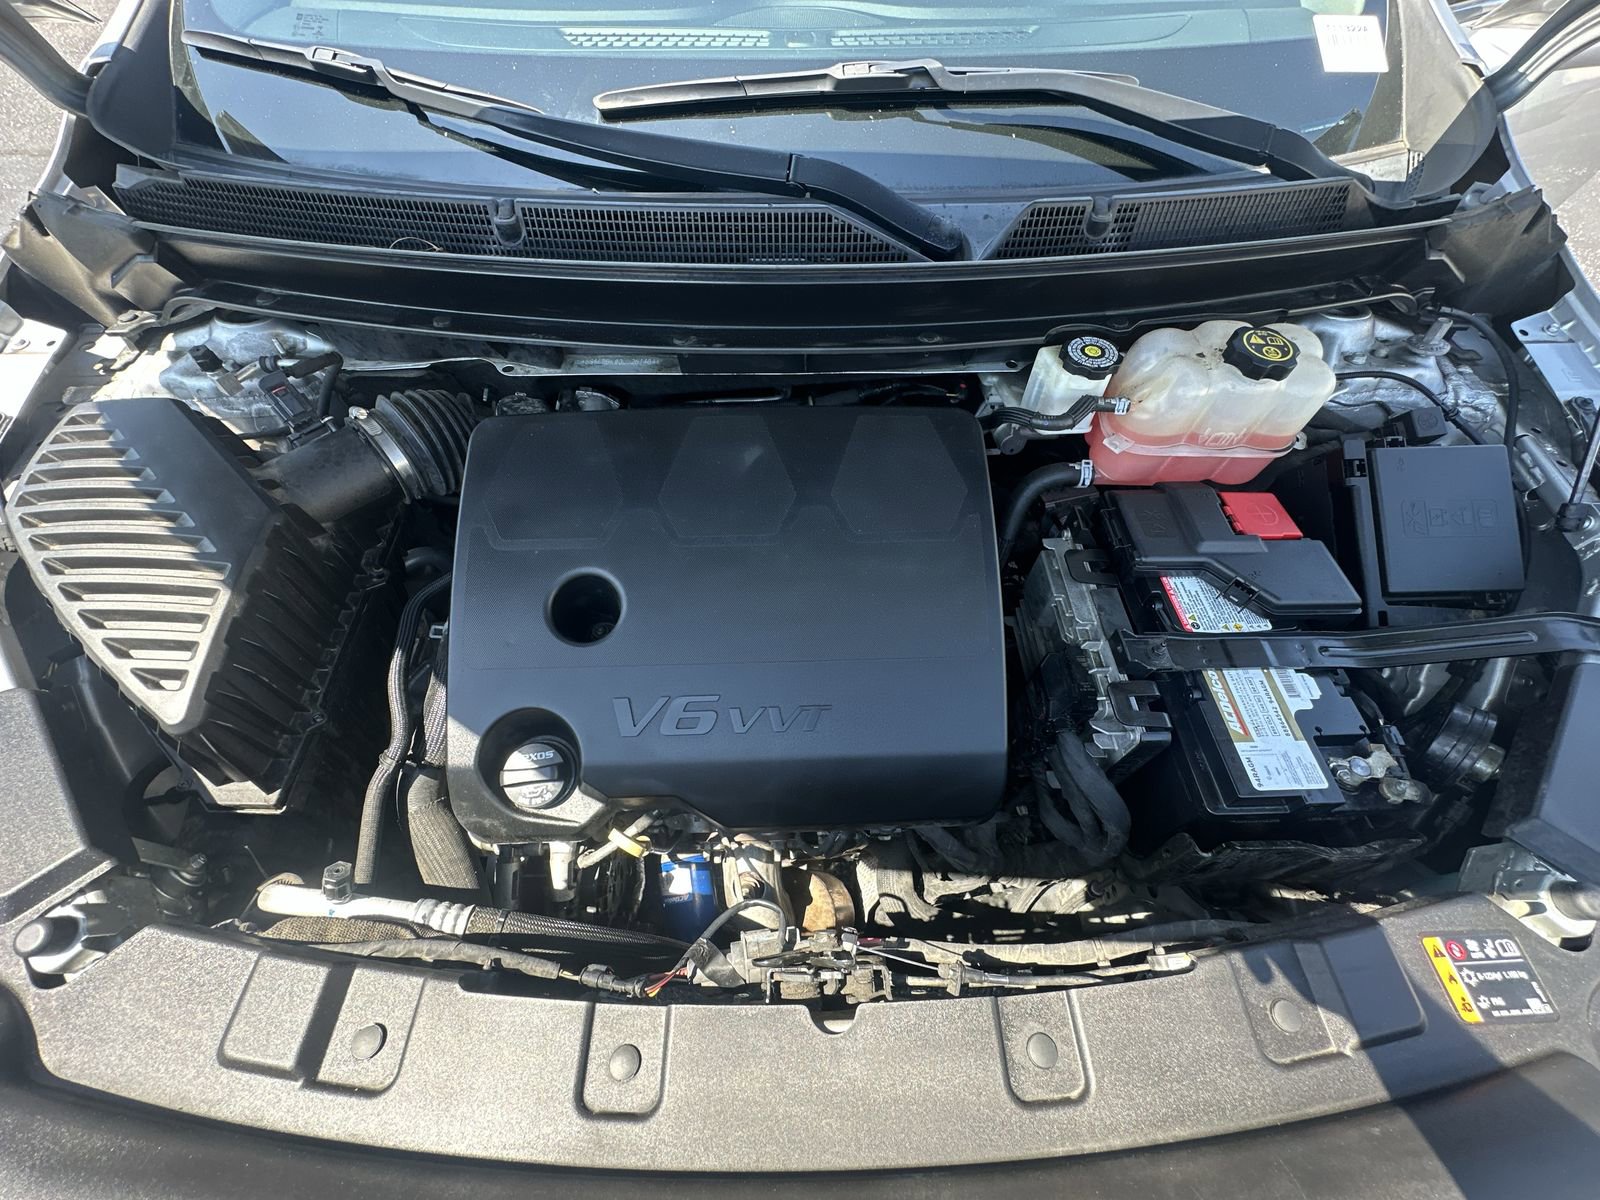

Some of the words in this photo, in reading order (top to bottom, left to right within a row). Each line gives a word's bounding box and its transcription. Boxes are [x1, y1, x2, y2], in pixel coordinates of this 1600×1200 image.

[1207, 670, 1244, 735] ACDelco
[1259, 680, 1275, 704] 94RAGM
[612, 694, 720, 738] V6
[728, 704, 833, 735] VVT
[1245, 757, 1264, 788] 94RAGM
